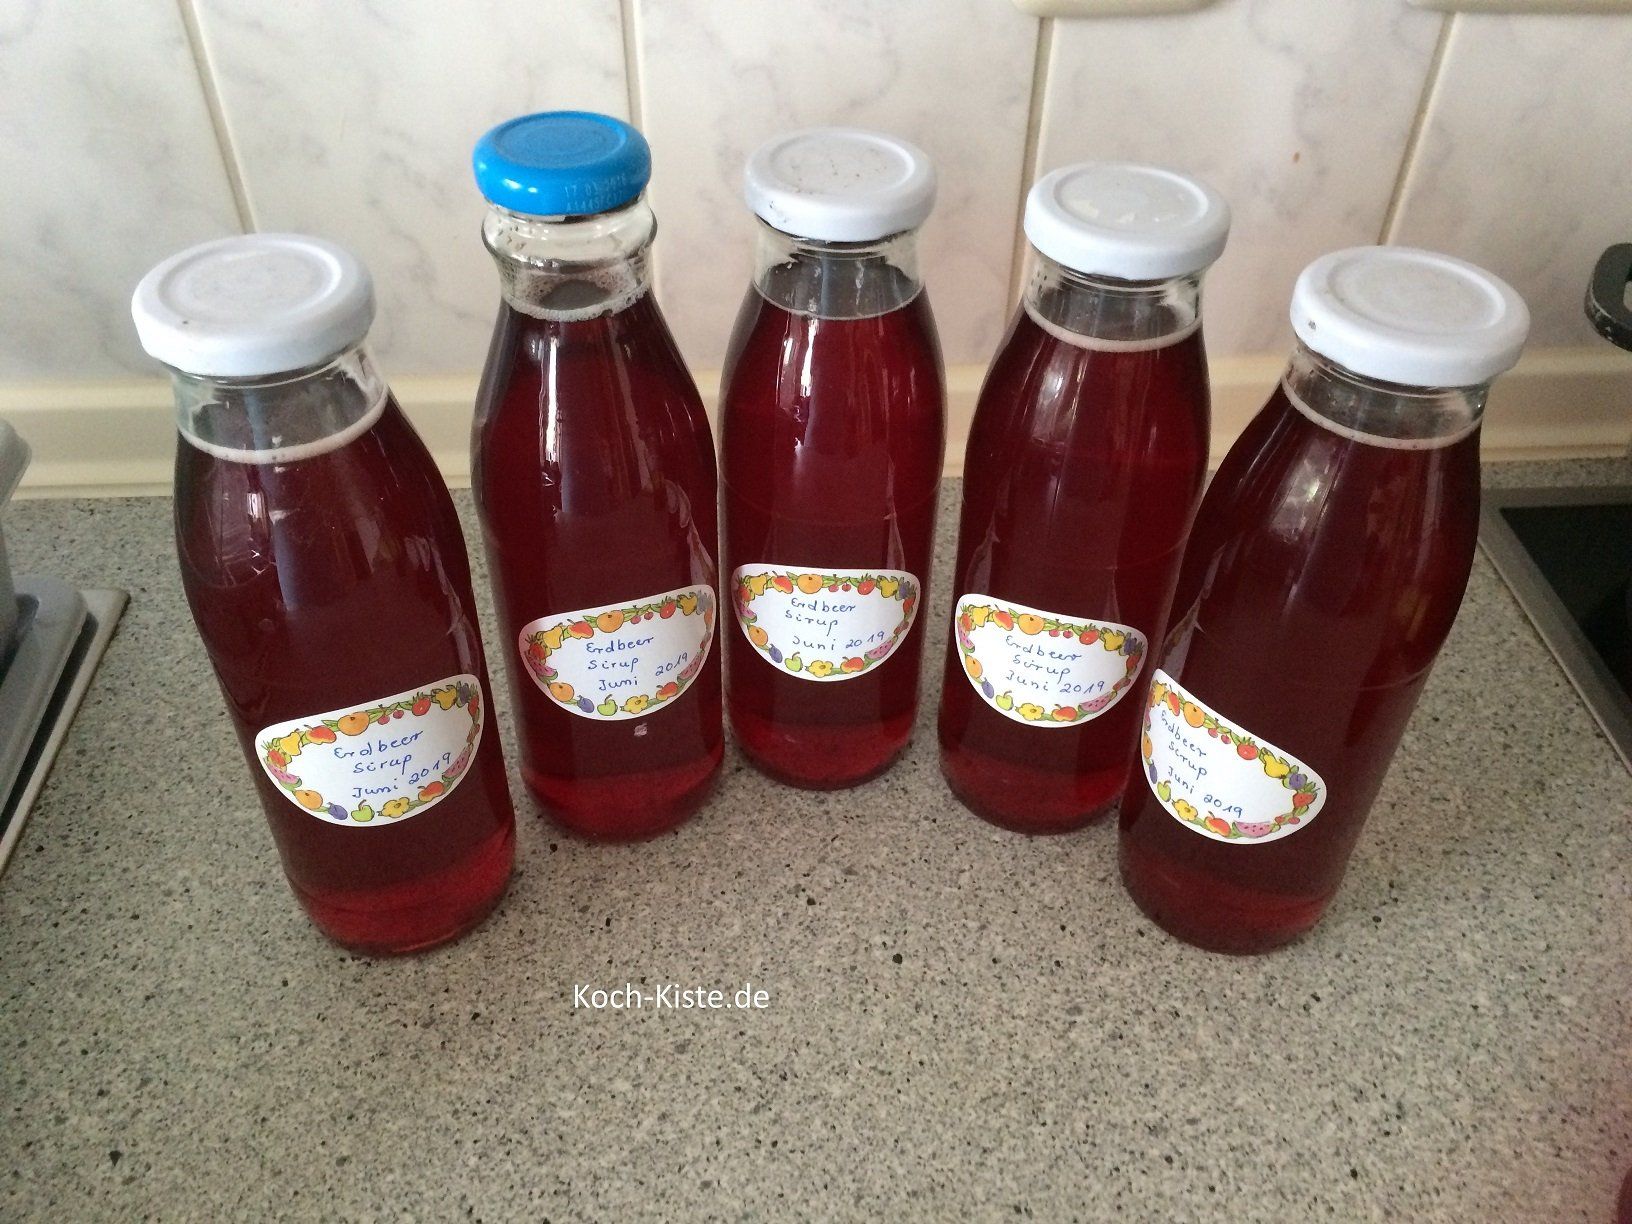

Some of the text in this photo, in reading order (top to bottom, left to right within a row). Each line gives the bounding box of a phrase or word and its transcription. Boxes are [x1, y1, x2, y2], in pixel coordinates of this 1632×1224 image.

[790, 597, 857, 613] Erdbeer
[785, 609, 839, 637] Sirup
[585, 636, 654, 654] Erdbeer
[792, 630, 885, 651] Juni 2019
[1005, 635, 1082, 662] Erdbeer
[587, 657, 639, 673] Sirup
[598, 652, 688, 691] Juni 2019
[1012, 655, 1071, 684] Sirup
[1005, 670, 1105, 694] Juni 2019
[333, 731, 424, 759] Erdbeer
[1161, 710, 1207, 758] Erdbeer
[352, 754, 412, 776] Sirup
[1168, 741, 1207, 780] Sirup
[351, 752, 451, 799] Juni 2019
[1167, 766, 1243, 818] Juni 2019
